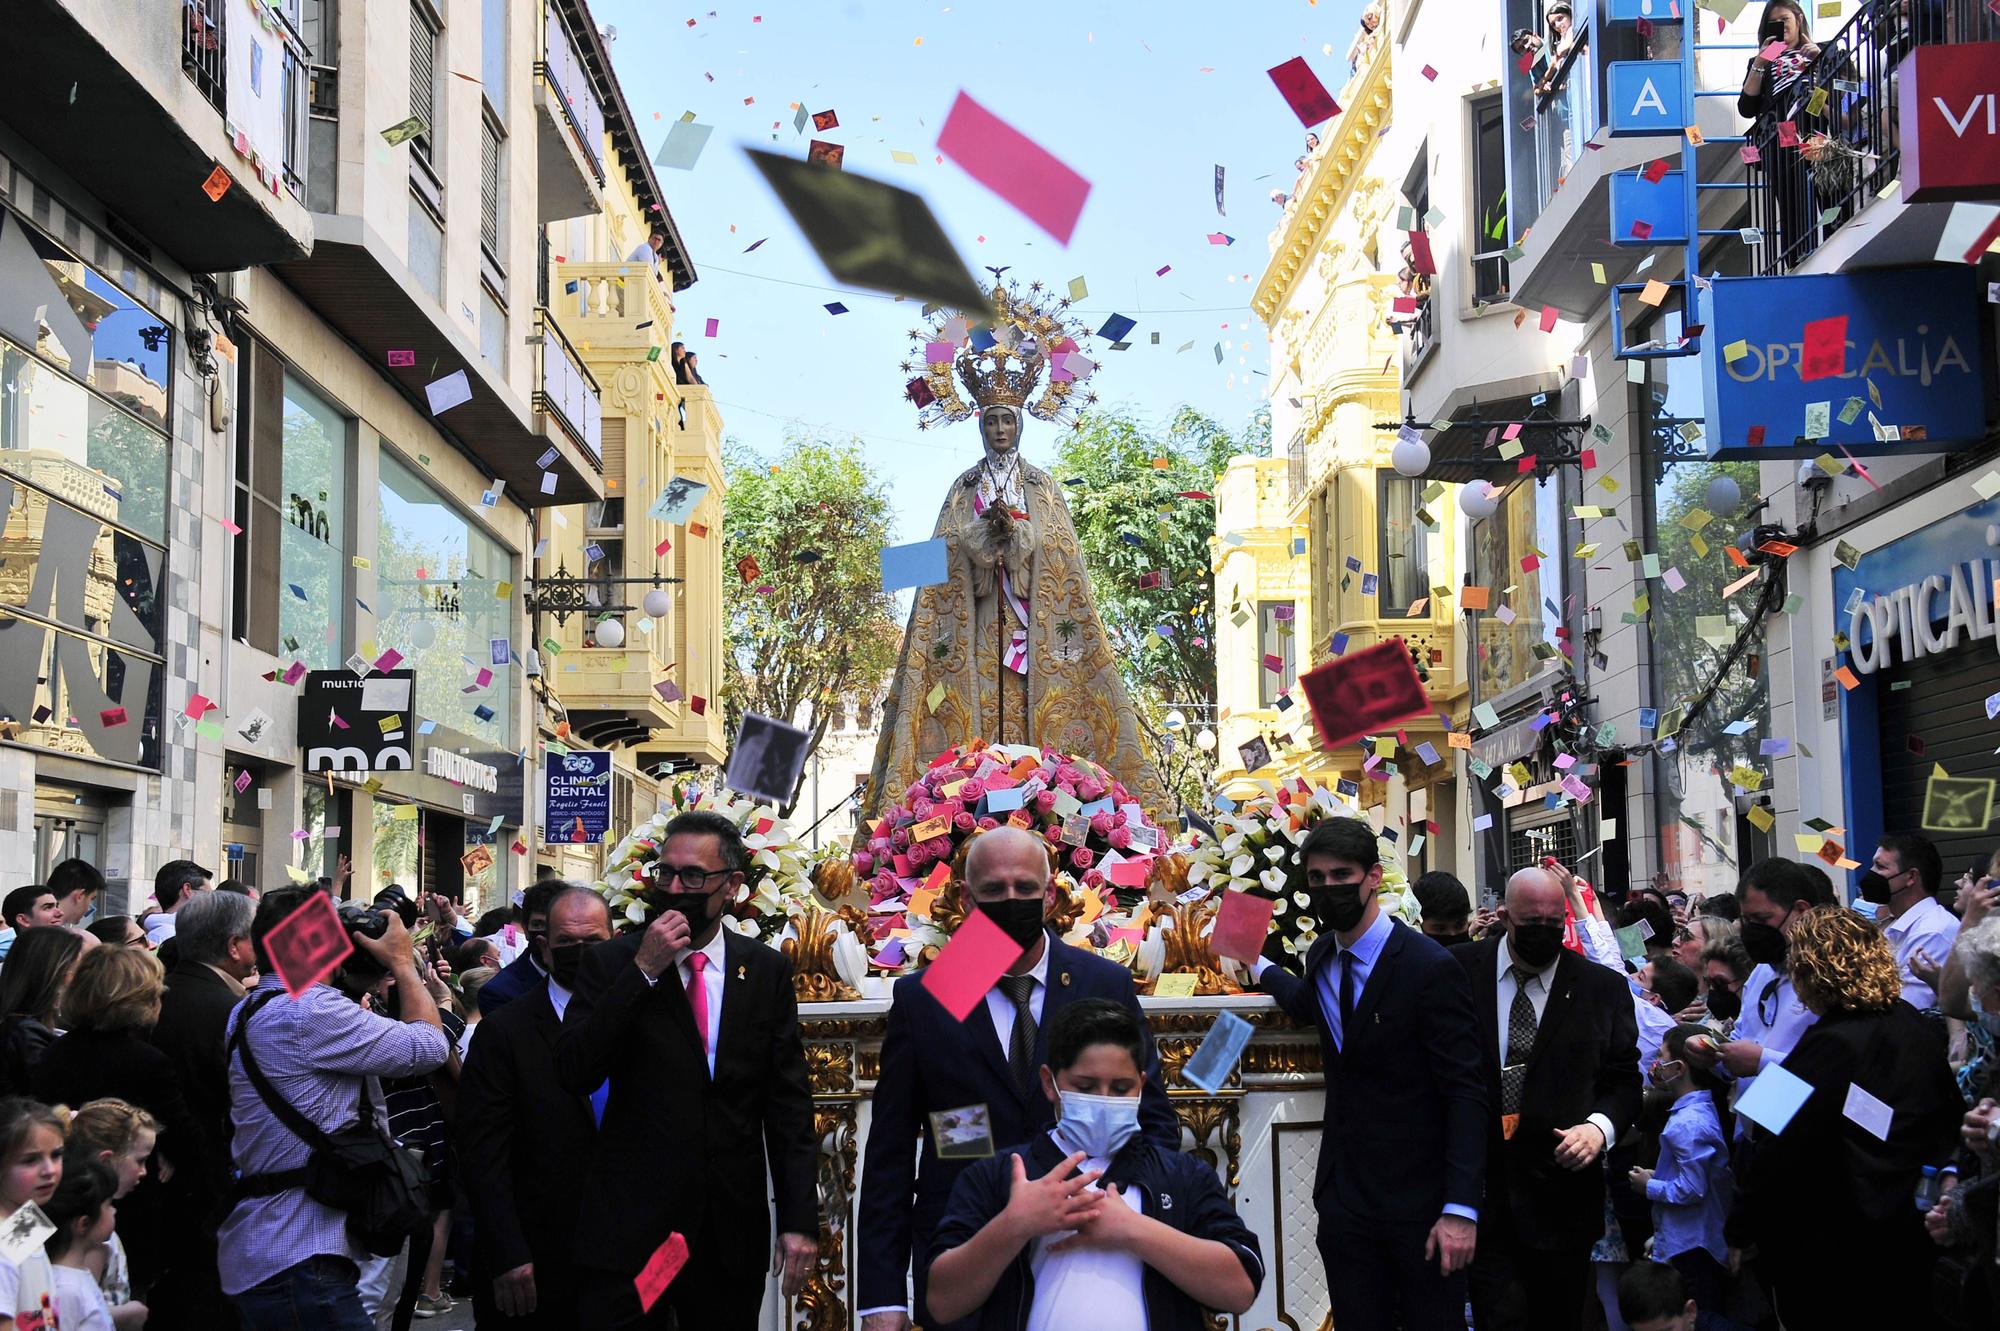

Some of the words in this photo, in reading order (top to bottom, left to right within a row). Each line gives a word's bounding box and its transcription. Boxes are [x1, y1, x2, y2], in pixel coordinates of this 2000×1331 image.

[550, 776, 606, 786] CLINIC
[550, 787, 605, 796] DENTAL
[560, 833, 569, 841] 96
